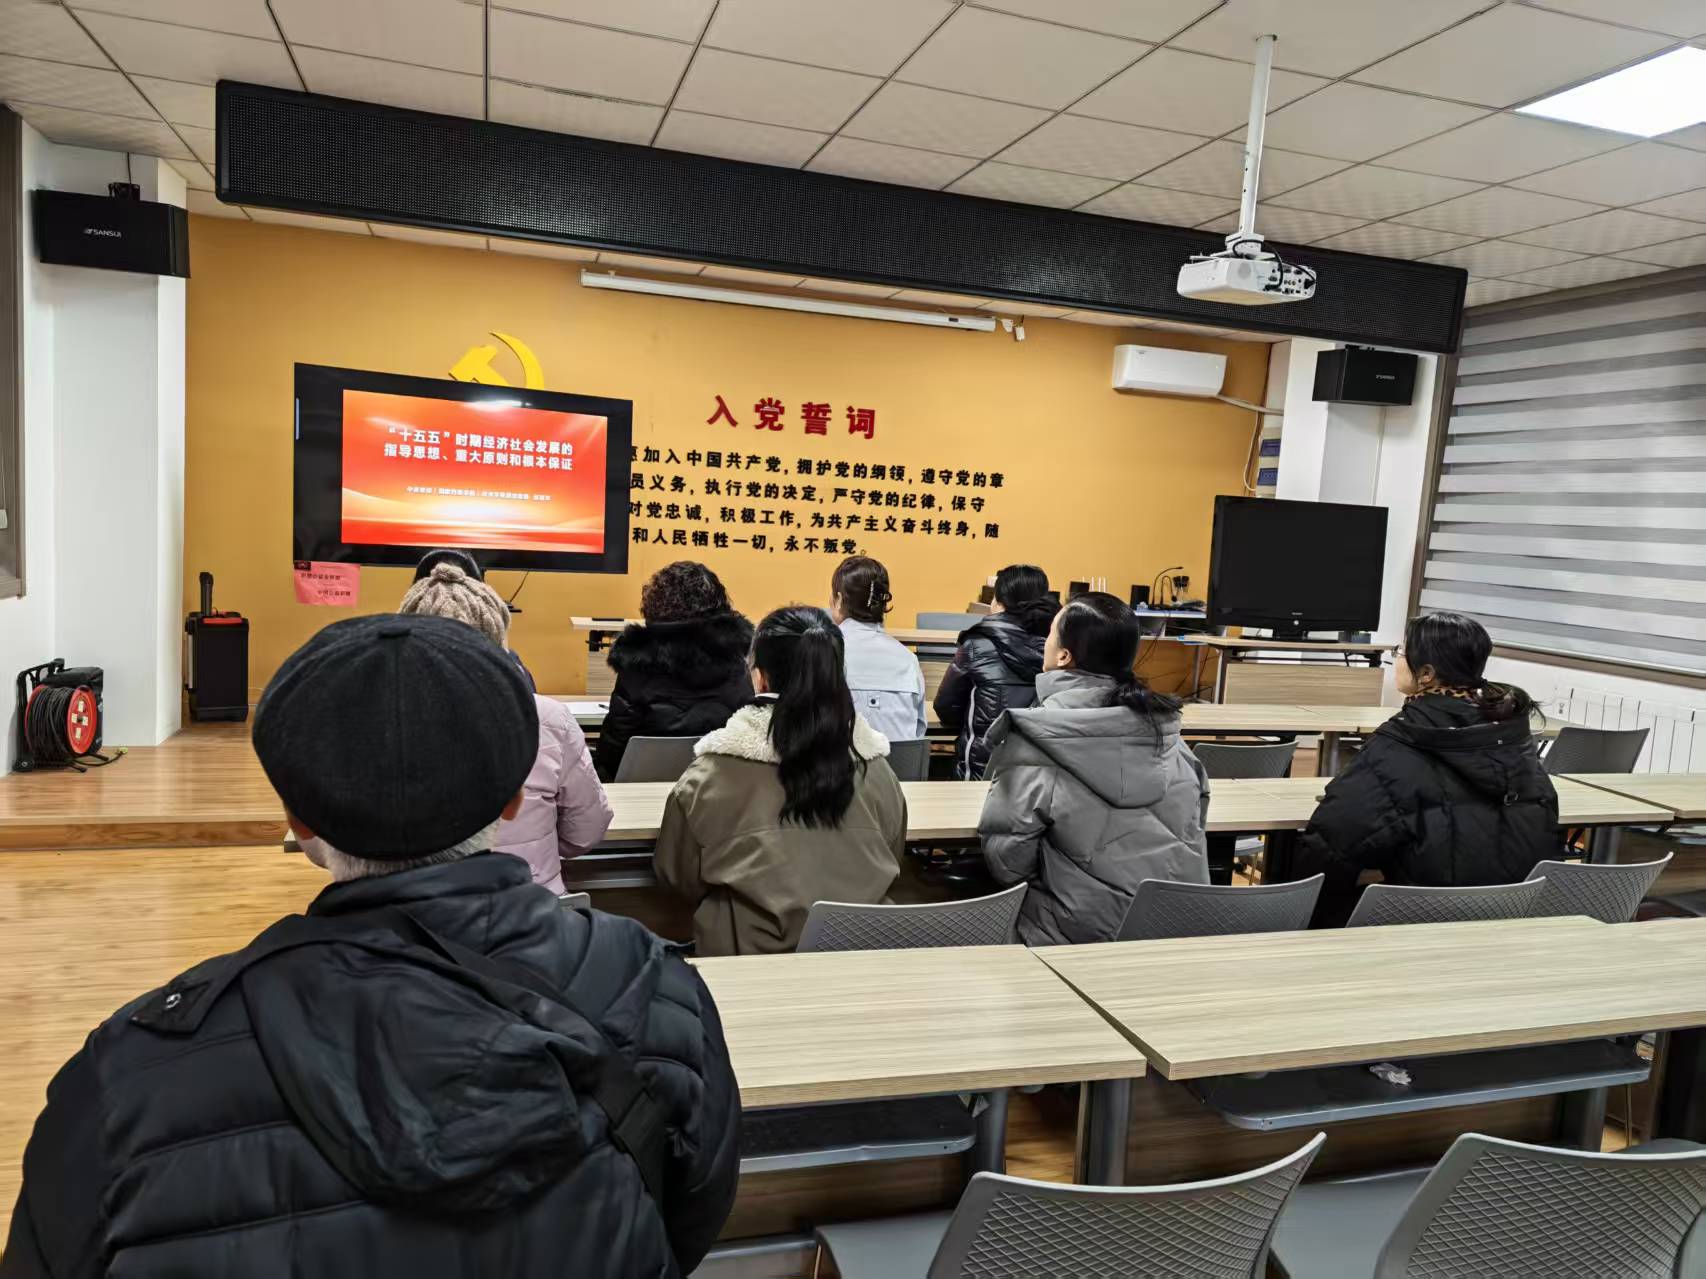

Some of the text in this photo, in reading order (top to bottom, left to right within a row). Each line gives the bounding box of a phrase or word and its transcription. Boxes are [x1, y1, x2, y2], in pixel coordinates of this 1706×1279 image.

[707, 395, 876, 439] 入党誓词
[383, 443, 573, 470] 指导思想、重大原则和根本保证
